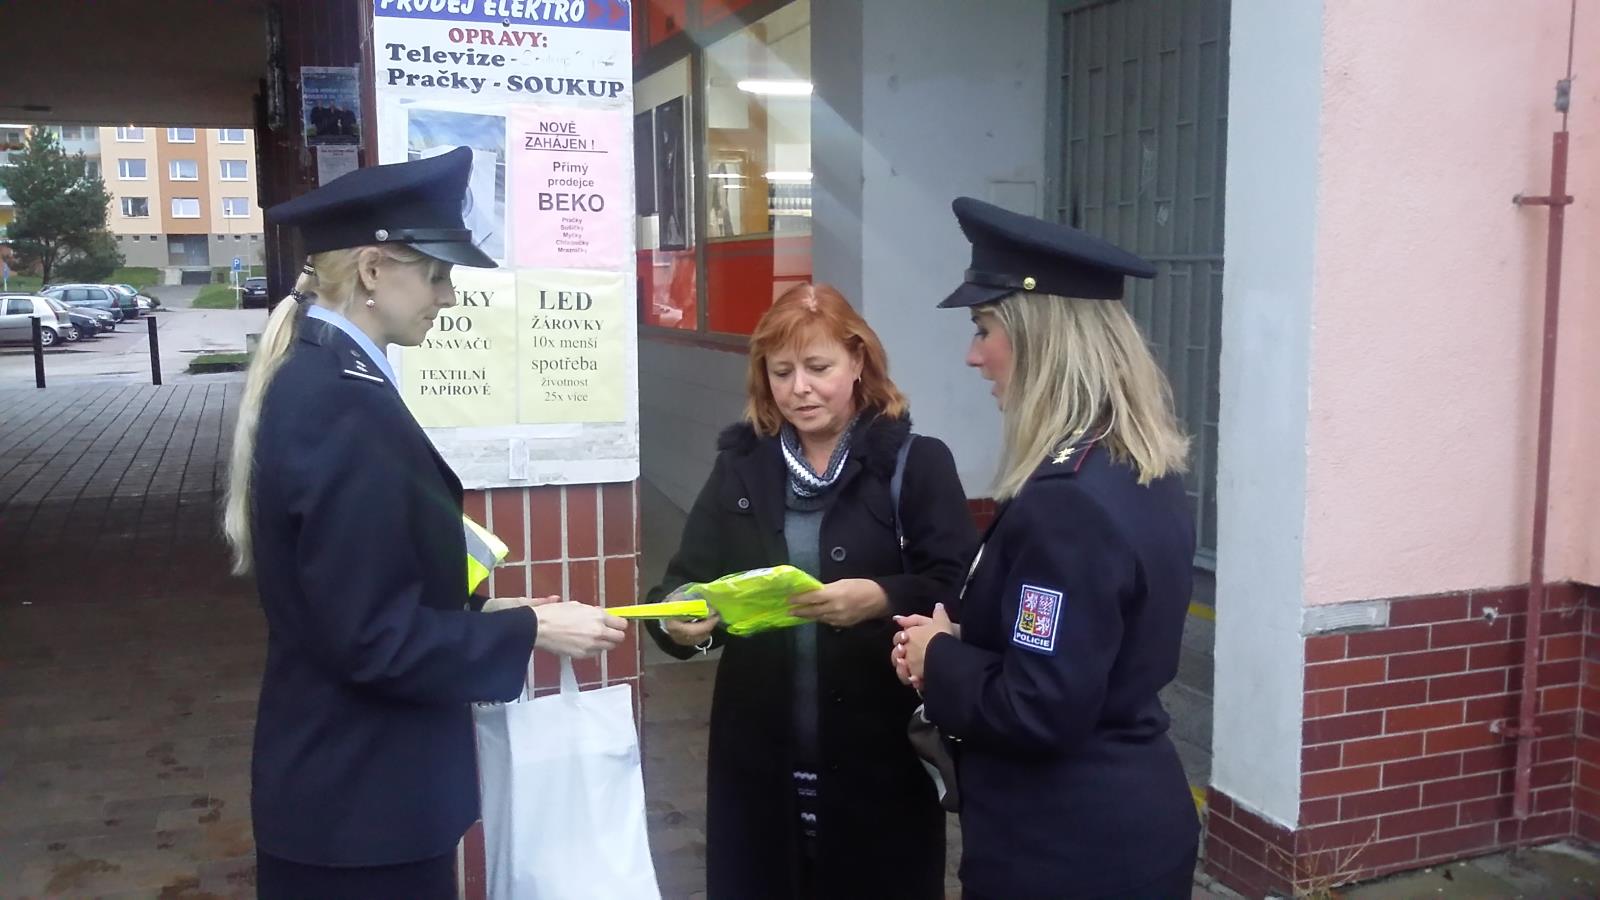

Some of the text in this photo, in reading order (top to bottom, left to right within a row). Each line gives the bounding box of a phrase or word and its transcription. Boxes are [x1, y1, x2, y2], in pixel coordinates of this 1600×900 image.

[483, 0, 586, 23] ELEKTRO
[448, 27, 548, 48] OPRAVY:
[385, 43, 506, 67] Televize
[387, 68, 487, 94] Pračky
[507, 75, 625, 99] SOUKUP
[525, 135, 587, 150] ZAHÁJEN
[553, 161, 589, 175] Přímý
[548, 178, 595, 189] prodejce
[538, 192, 605, 213] BEKO
[539, 290, 593, 311] LED
[439, 315, 473, 332] DO
[531, 315, 604, 331] ŽÁROVKY
[533, 335, 598, 349] 10x menší
[531, 356, 598, 374] spotřeba
[420, 367, 487, 380] TEXTILNÍ
[420, 382, 492, 396] PAPÍROVÉ
[541, 377, 588, 387] životnost
[544, 391, 564, 402] 25x
[1016, 632, 1050, 647] POLICIE
